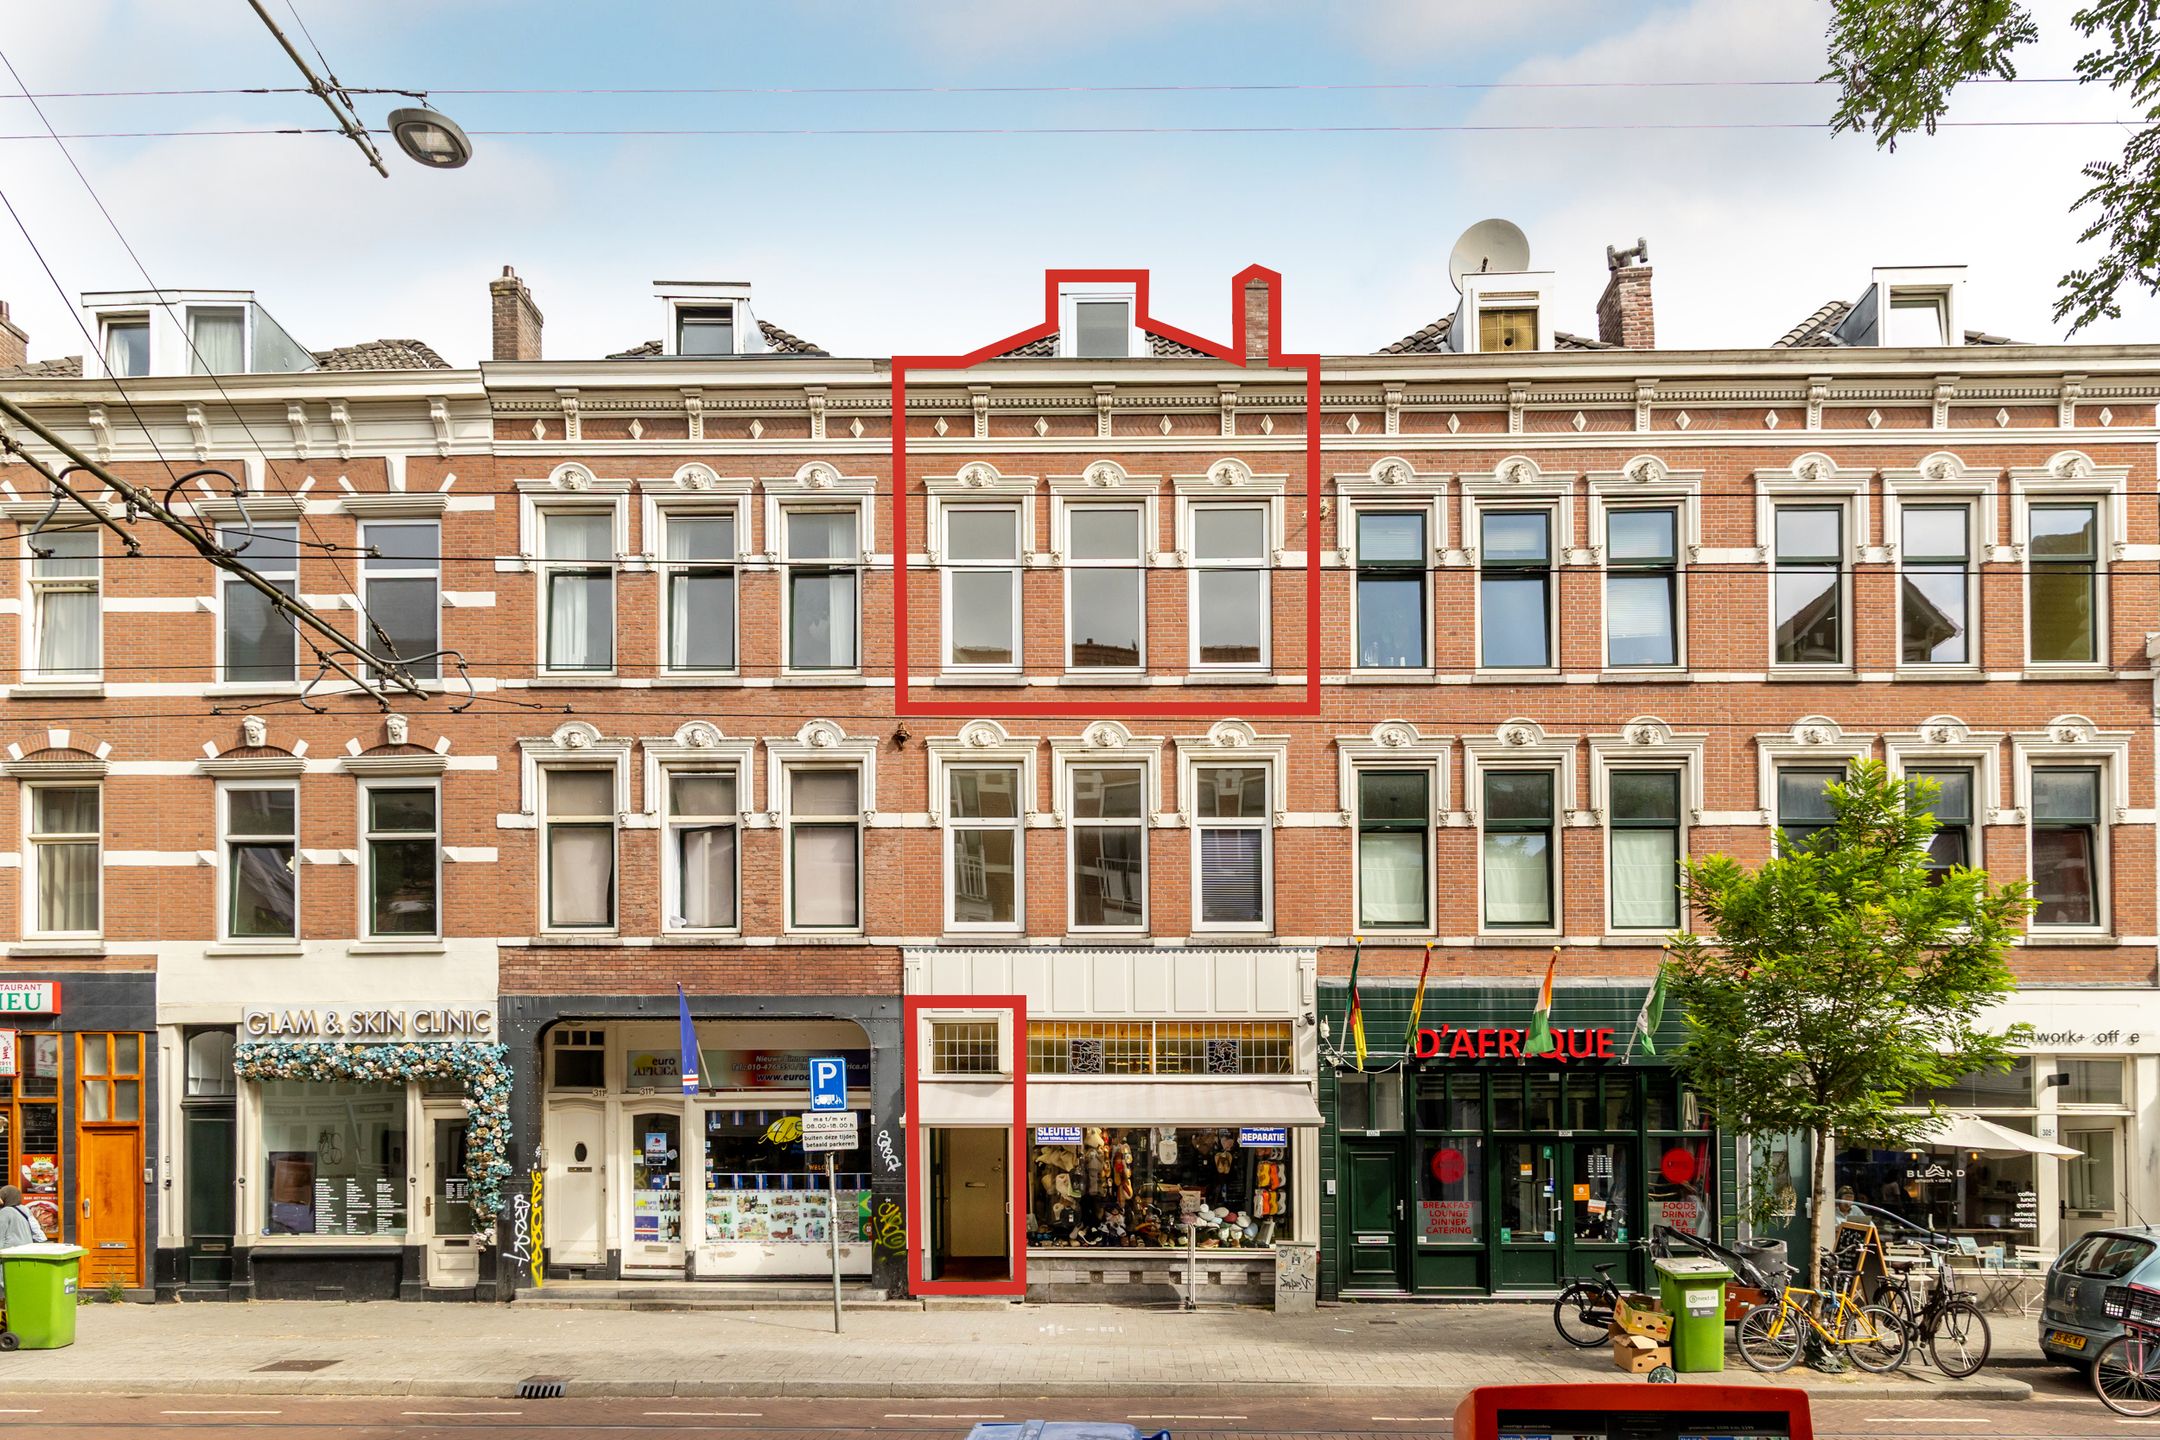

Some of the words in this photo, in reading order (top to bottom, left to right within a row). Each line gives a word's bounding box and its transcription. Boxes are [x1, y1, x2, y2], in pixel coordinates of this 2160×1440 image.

[246, 1011, 317, 1035] GLAM
[324, 1011, 341, 1034] &
[351, 1010, 405, 1034] SKIN
[413, 1009, 490, 1034] CLINIC
[652, 1058, 676, 1066] euro
[757, 1073, 811, 1081] www.euroa
[818, 1063, 837, 1088] P
[1038, 1127, 1081, 1136] SLEUTELS
[1242, 1133, 1285, 1141] REPARATIE
[1423, 1201, 1474, 1209] BREAKFAST
[1431, 1218, 1467, 1226] DINNER
